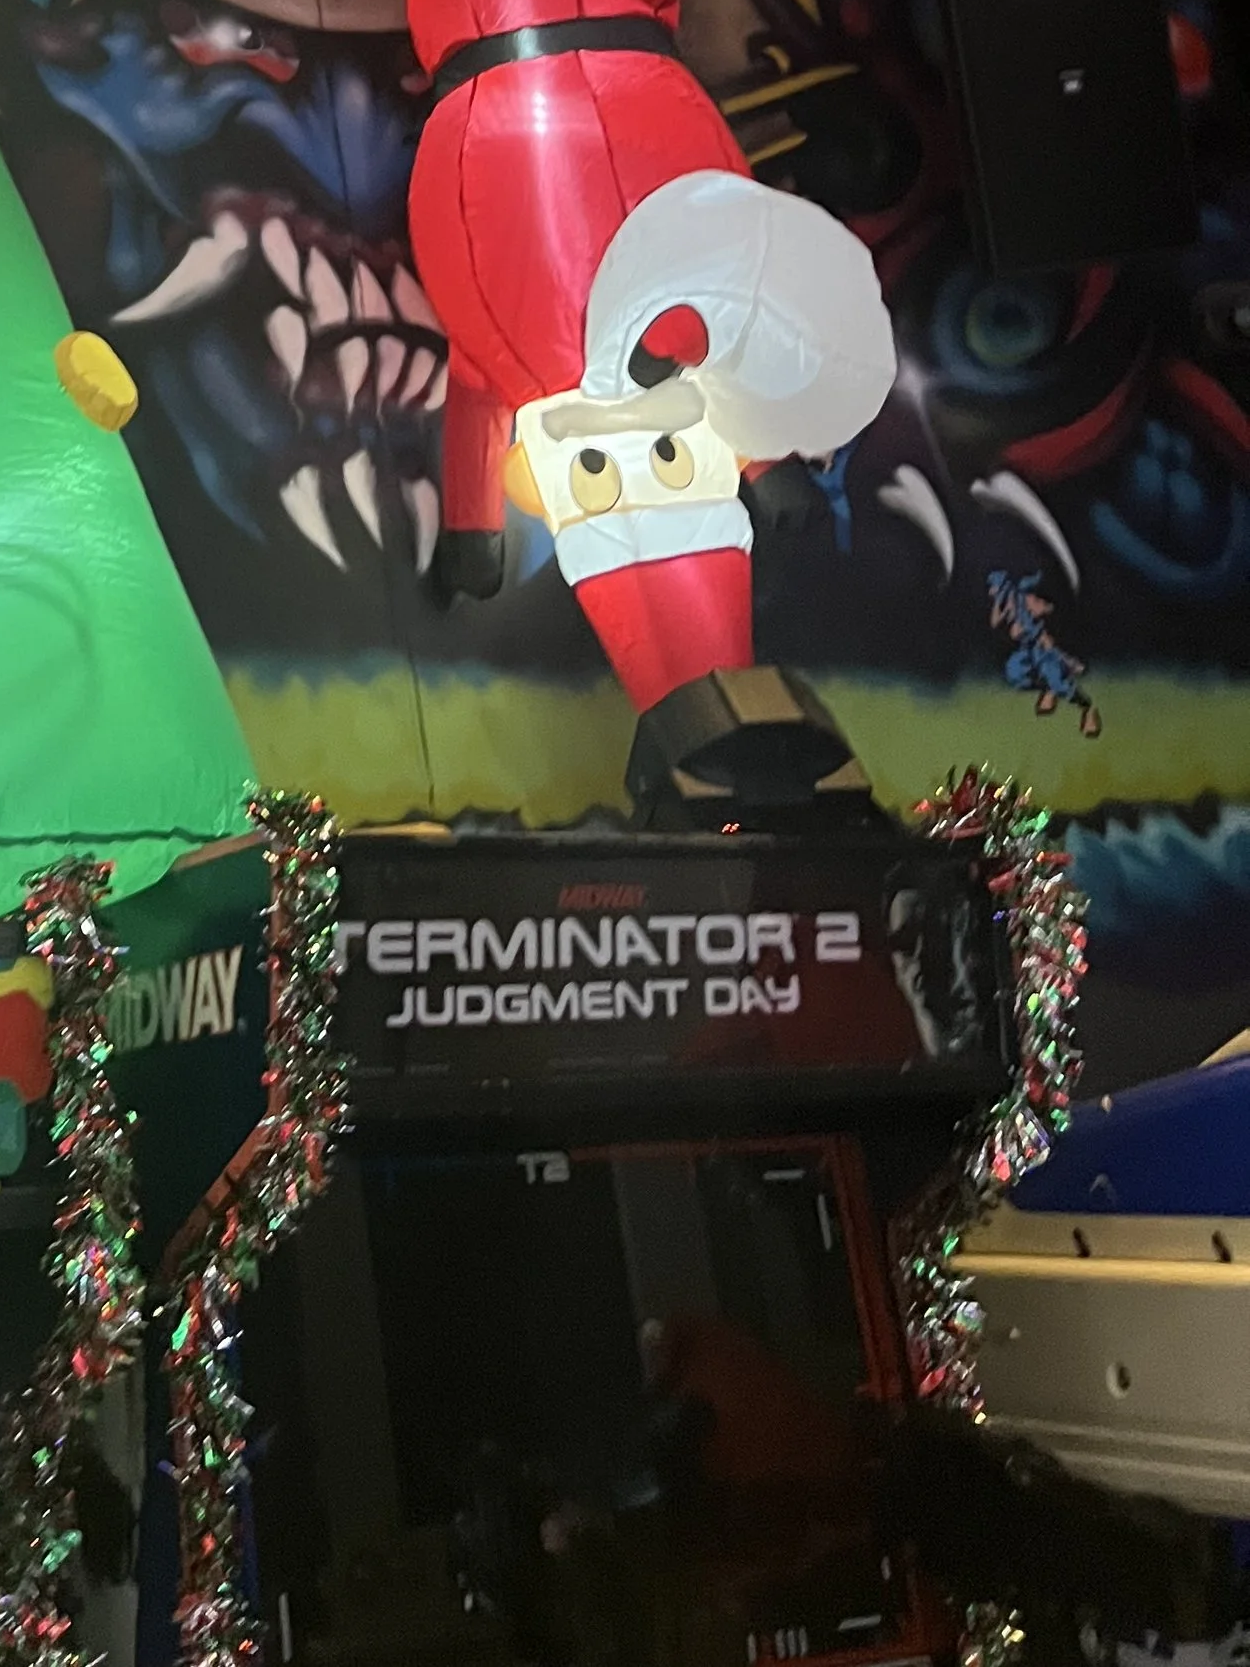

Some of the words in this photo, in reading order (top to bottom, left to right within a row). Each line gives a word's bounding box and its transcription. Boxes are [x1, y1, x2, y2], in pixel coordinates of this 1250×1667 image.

[333, 914, 795, 974] TERMINATOR
[815, 911, 862, 962] 2
[387, 979, 689, 1028] JUDGMENT
[704, 974, 800, 1017] DAY
